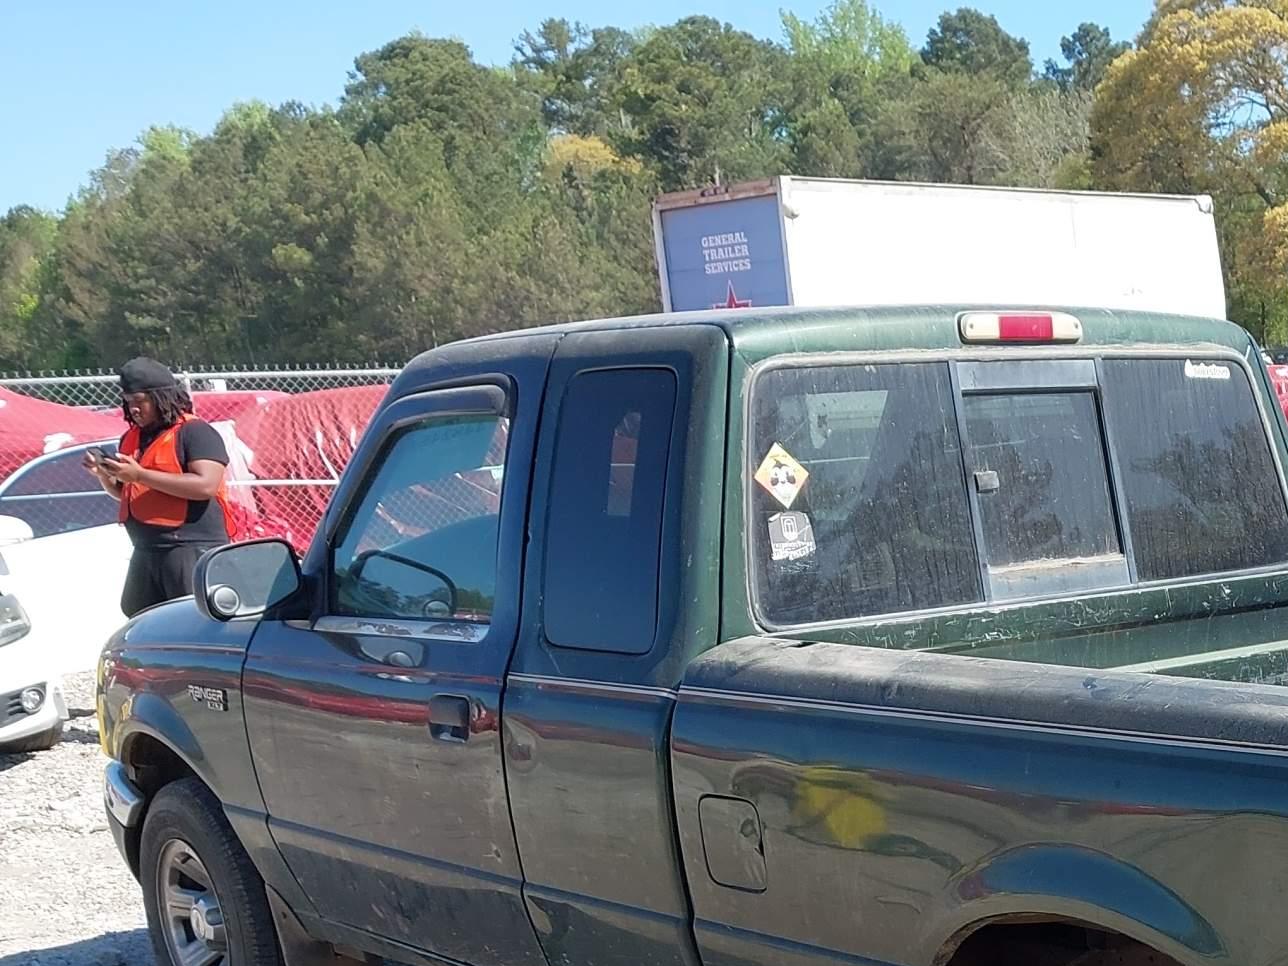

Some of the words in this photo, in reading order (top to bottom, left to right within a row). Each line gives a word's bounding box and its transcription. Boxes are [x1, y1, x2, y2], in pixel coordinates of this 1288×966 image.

[701, 232, 747, 248] GENERAL
[703, 244, 749, 261] TRAILER
[704, 258, 751, 274] SERVICES
